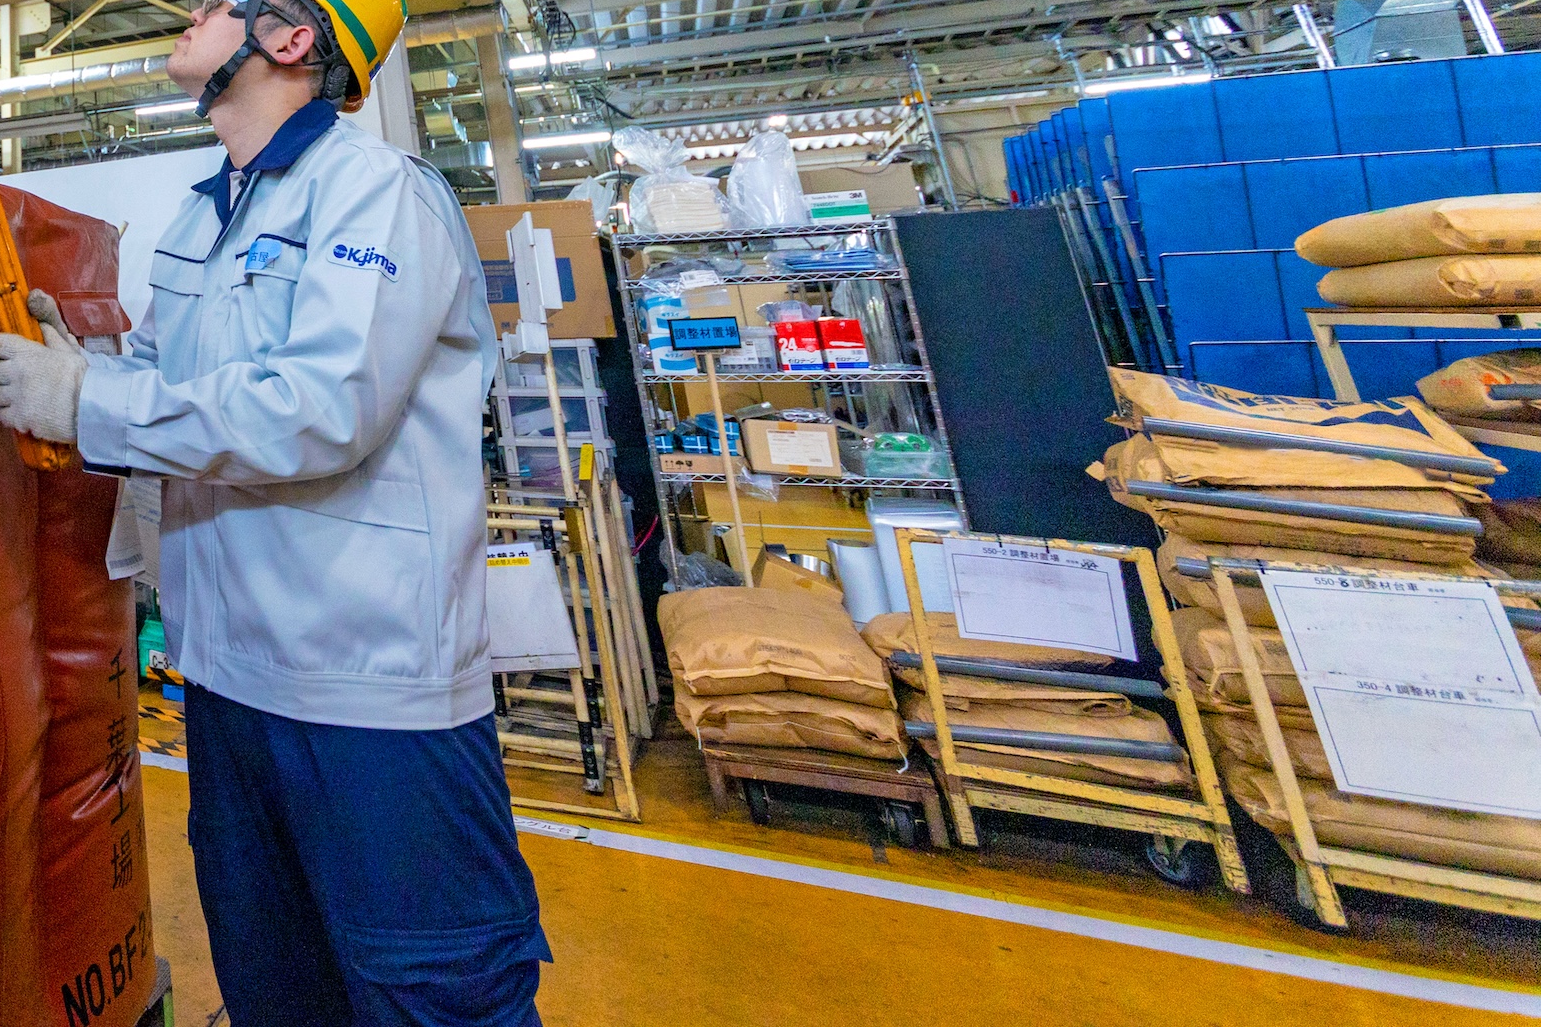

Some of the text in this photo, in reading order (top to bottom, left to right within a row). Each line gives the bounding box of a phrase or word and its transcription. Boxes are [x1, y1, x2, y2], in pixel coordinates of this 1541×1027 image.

[674, 326, 738, 340] 調整材置場
[778, 337, 798, 351] 24
[1009, 549, 1060, 562] 調整材置場
[1352, 578, 1419, 592] 調整材台車
[1395, 683, 1466, 701] 調整材台車
